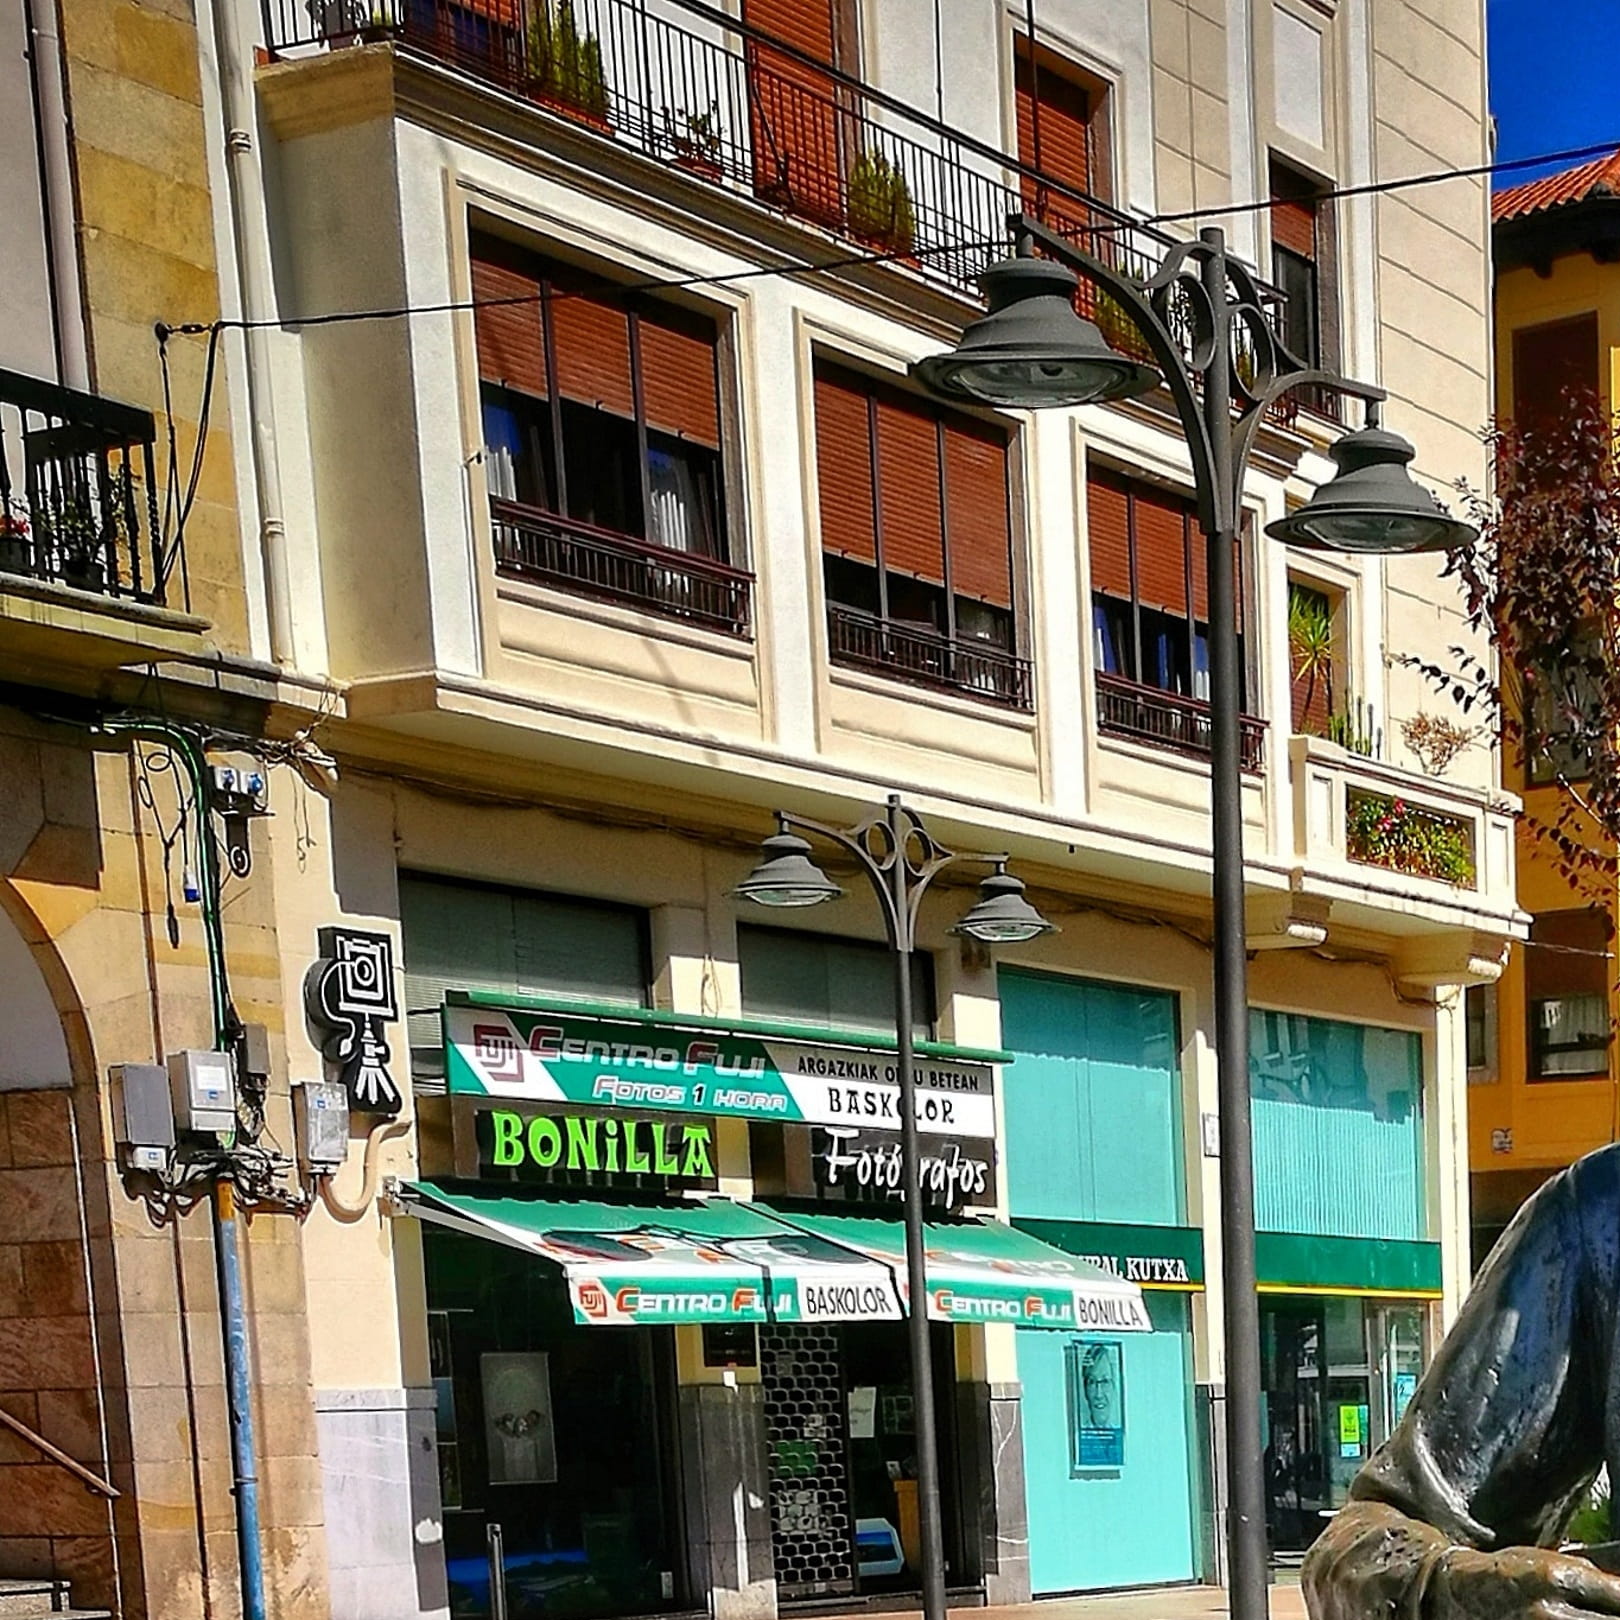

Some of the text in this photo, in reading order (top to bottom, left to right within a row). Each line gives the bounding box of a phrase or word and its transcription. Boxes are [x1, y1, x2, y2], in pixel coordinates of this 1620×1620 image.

[528, 1025, 766, 1080] CENTRO FUJI
[798, 1056, 979, 1091] ARGAZKIAK OU BETEAN
[592, 1075, 788, 1113] FOTOS 1 HORA
[827, 1087, 955, 1124] BASKLOR
[824, 1126, 989, 1210] Fotórafos
[1126, 1257, 1190, 1282] KUTXA
[616, 1287, 727, 1315] CENTRO
[806, 1284, 893, 1315] BASKOLOR
[934, 1291, 1073, 1322] CENTRO FUJI
[1080, 1296, 1144, 1327] BONILLA
